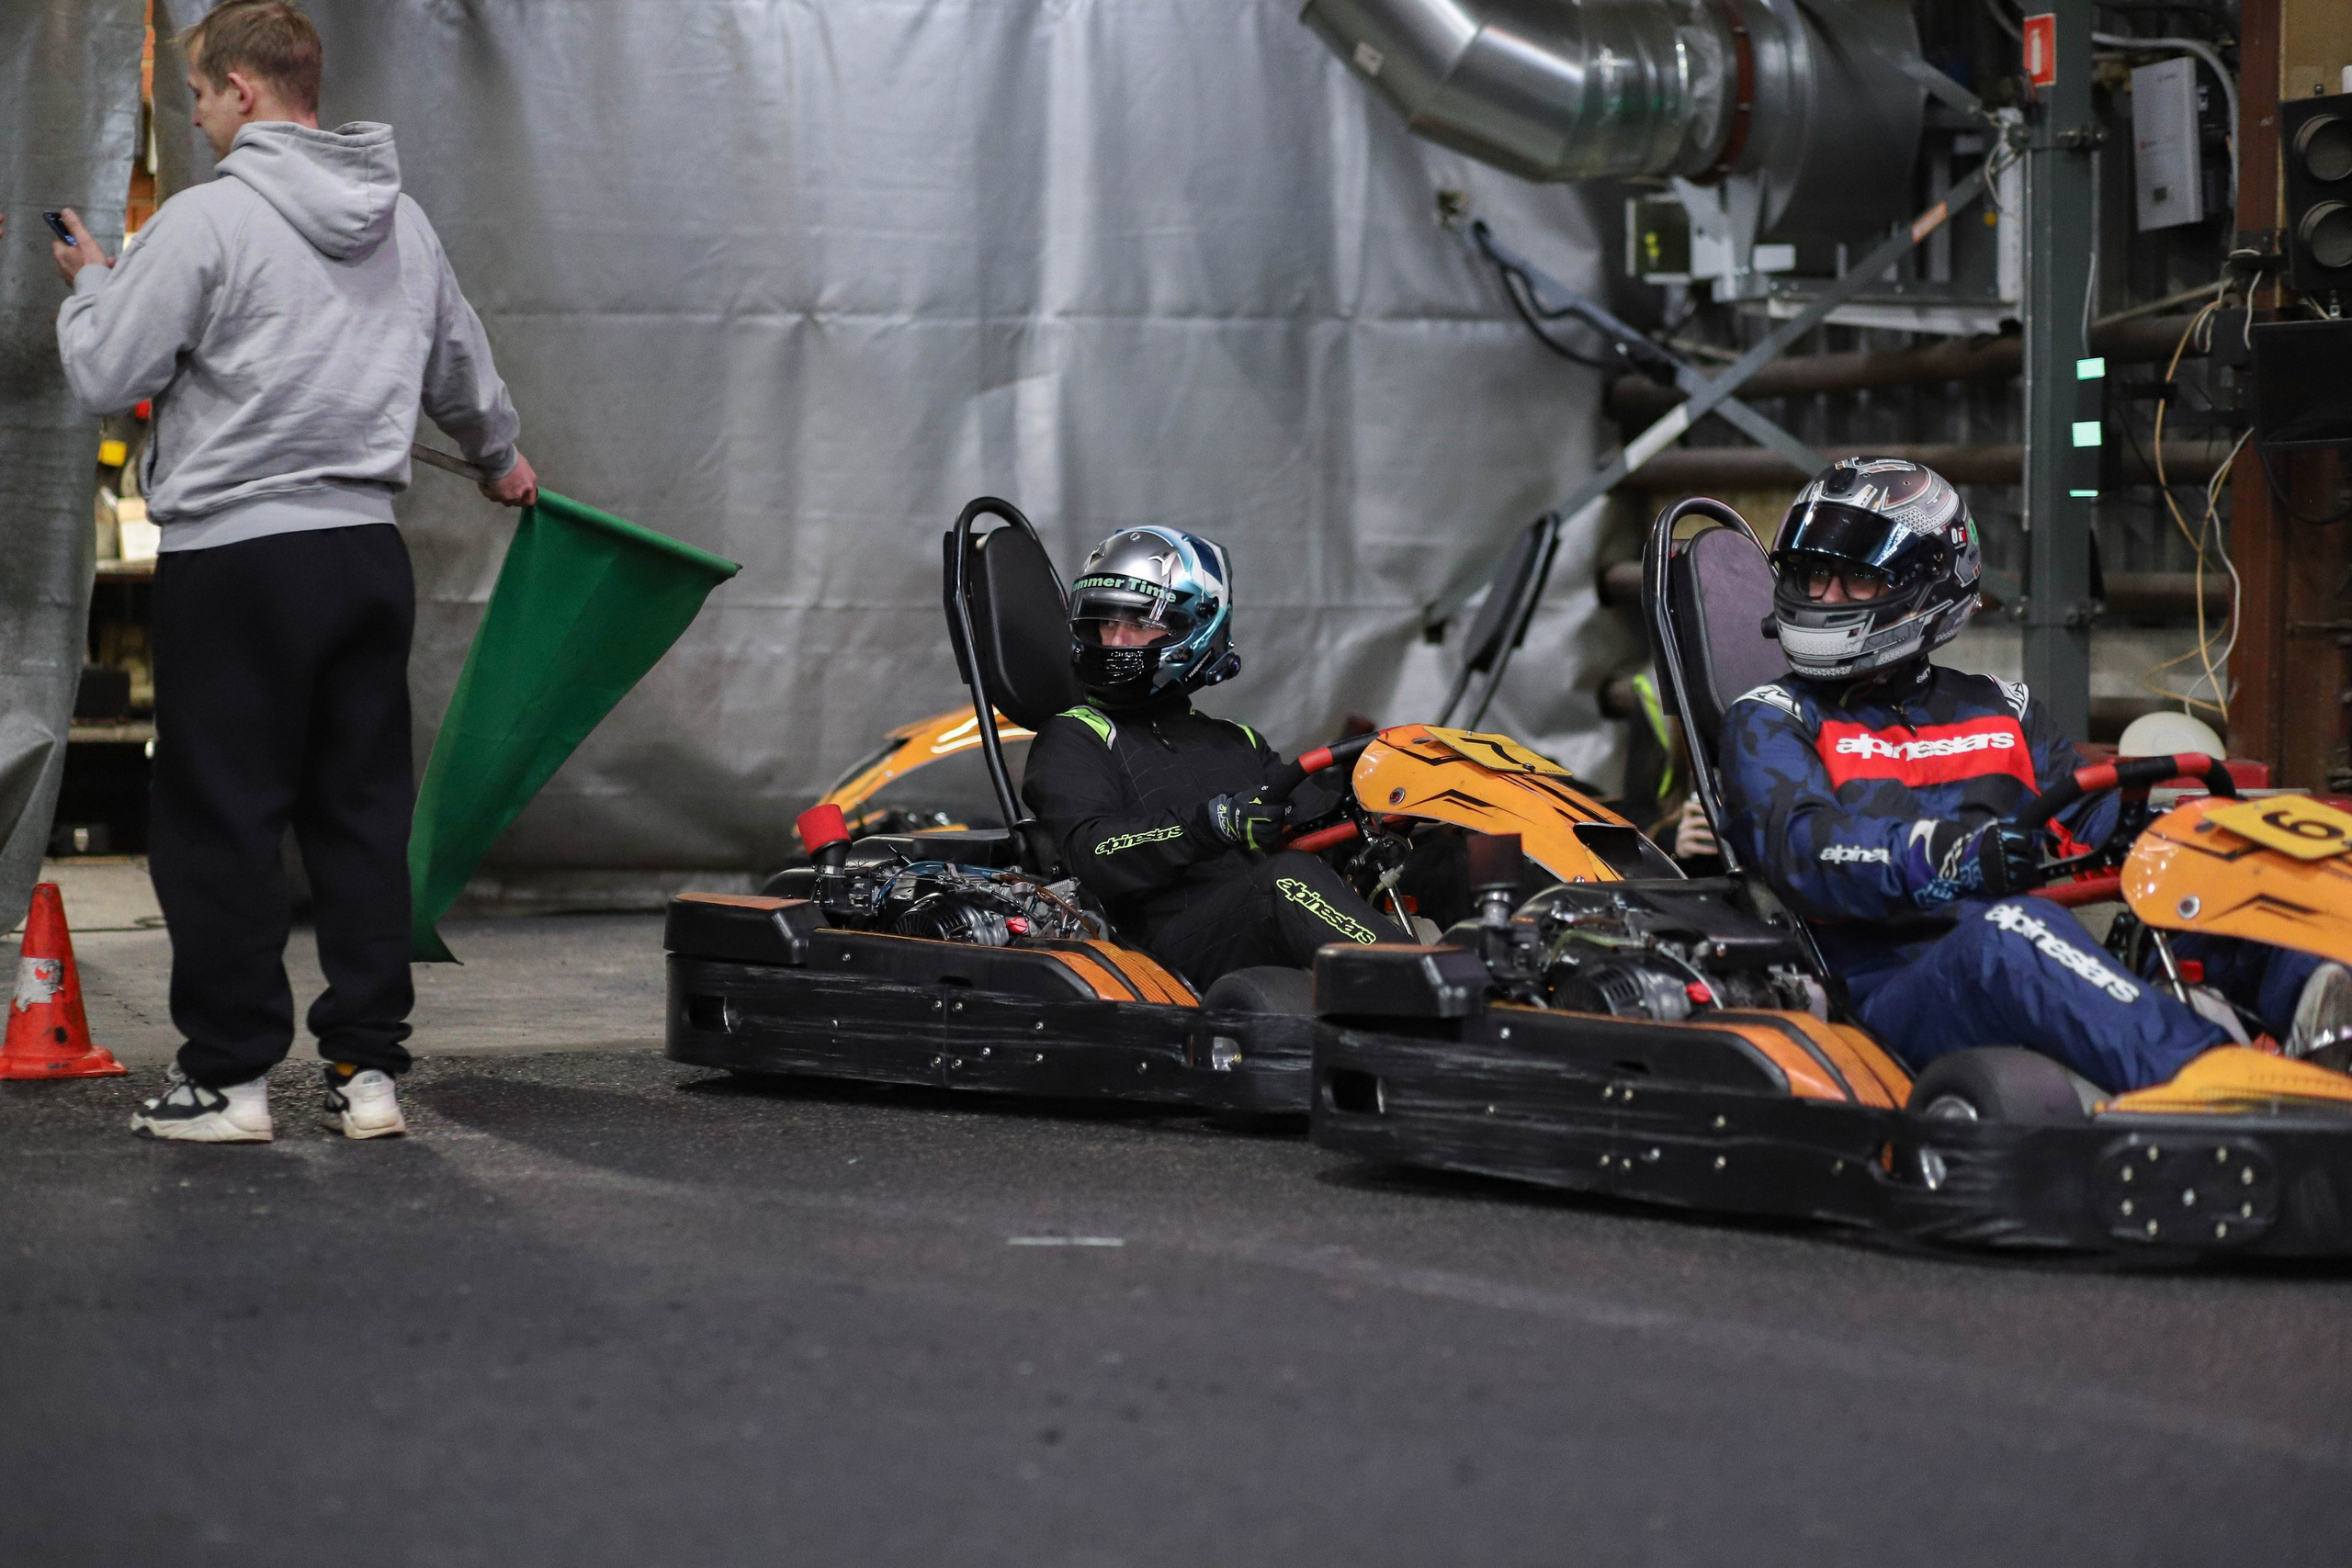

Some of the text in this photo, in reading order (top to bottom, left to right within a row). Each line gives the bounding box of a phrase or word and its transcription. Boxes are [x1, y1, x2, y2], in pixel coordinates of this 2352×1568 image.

[1128, 577, 1176, 603] Time
[1459, 738, 1522, 764] 7
[1836, 732, 2015, 761] alpinestars
[2262, 810, 2346, 840] 6
[1276, 878, 1376, 945] alpinestars
[1984, 904, 2140, 1003] alpinestars
